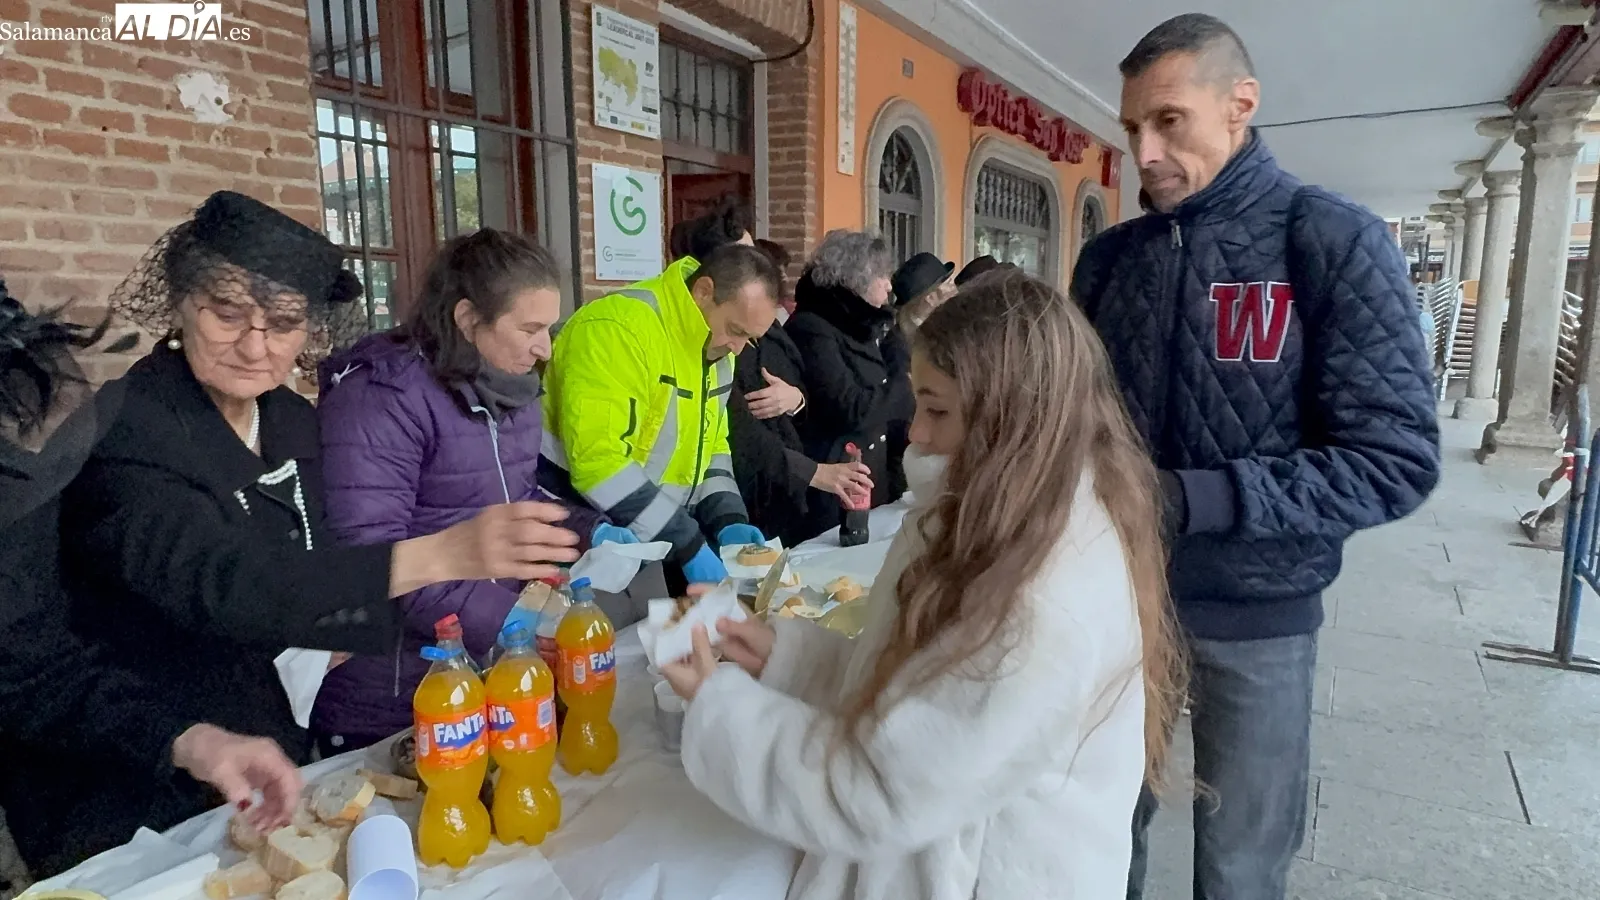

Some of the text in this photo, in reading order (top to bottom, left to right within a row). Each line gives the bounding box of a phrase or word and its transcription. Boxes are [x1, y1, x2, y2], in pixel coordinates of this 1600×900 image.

[1208, 280, 1294, 363] W
[588, 645, 615, 670] FAN
[432, 712, 486, 744] FANTA
[488, 704, 515, 725] NTA
